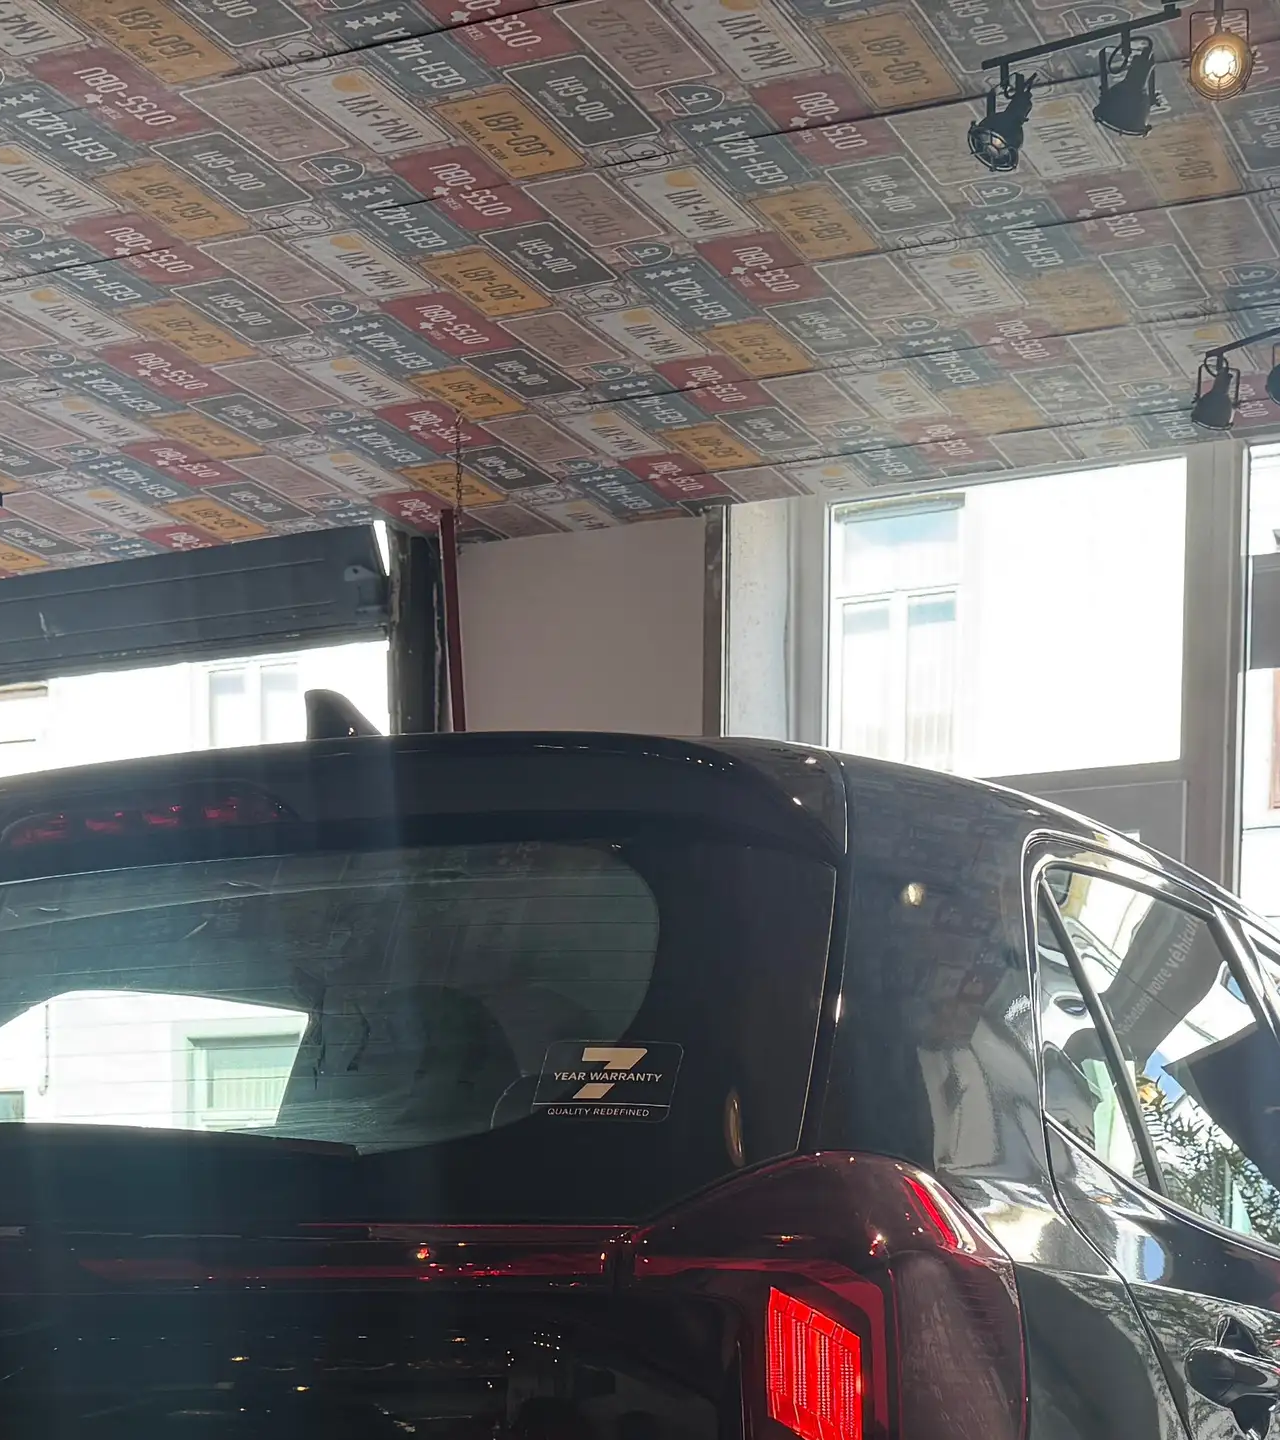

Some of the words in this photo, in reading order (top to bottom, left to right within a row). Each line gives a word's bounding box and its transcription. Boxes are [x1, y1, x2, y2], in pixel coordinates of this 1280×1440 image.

[678, 90, 715, 105] 15
[321, 162, 357, 176] 15
[980, 185, 1013, 198] 15
[554, 1072, 586, 1081] YEAR
[590, 1072, 662, 1082] WARRANTY
[547, 1107, 591, 1116] QUALITY
[593, 1108, 650, 1117] REDEFINED
